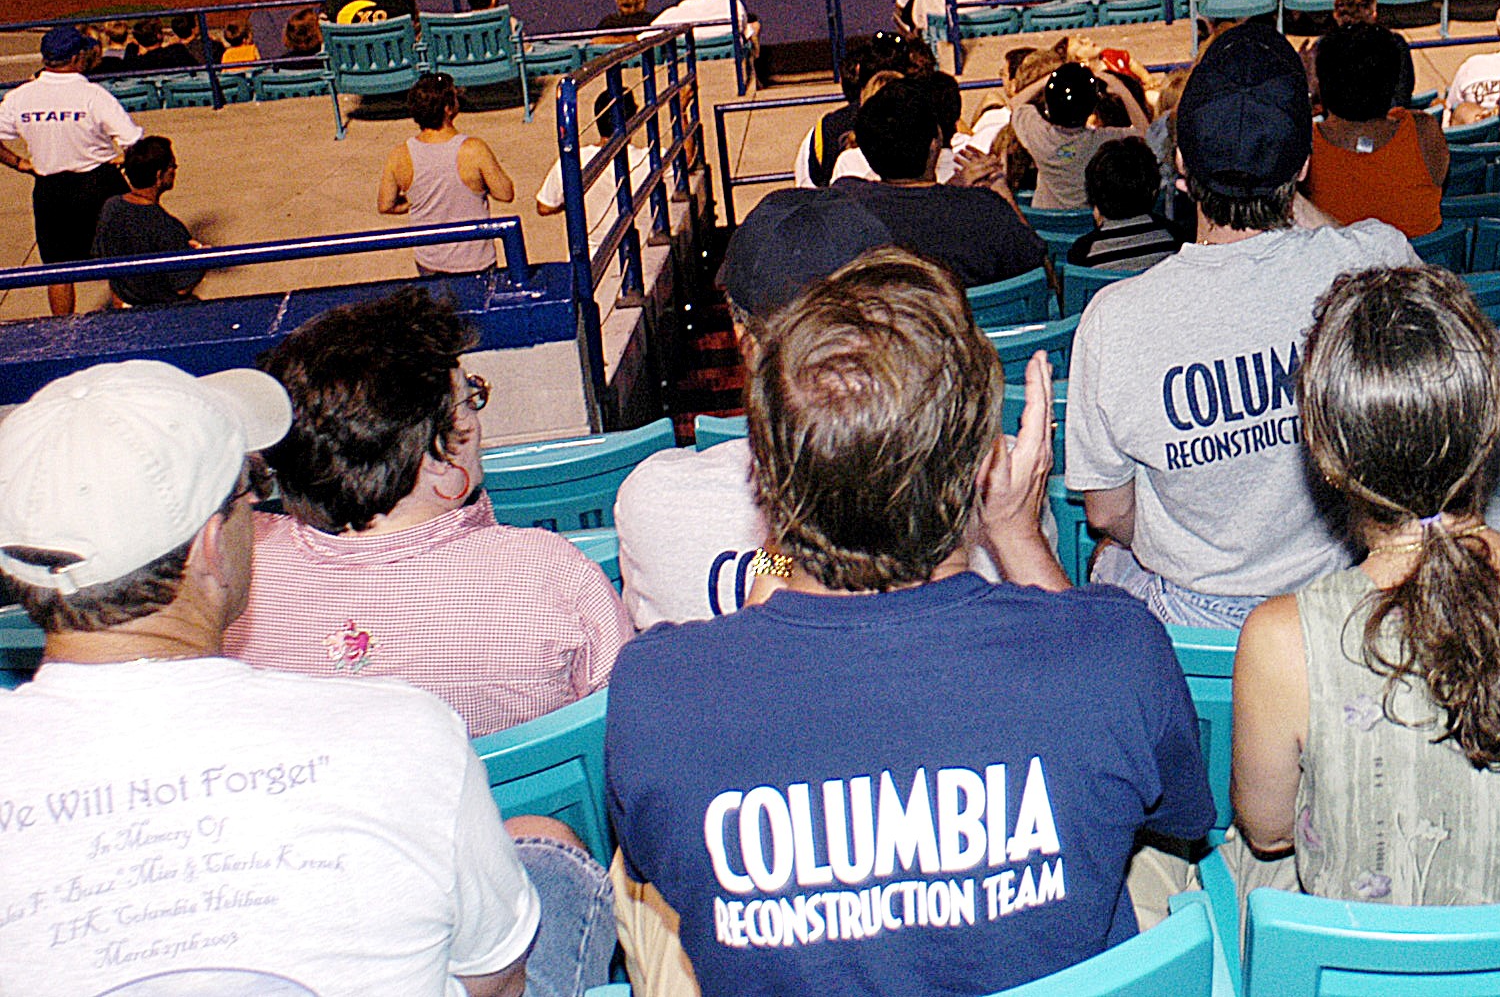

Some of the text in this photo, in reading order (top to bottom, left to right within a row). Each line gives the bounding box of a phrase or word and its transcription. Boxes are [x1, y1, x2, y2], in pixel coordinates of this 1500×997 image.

[21, 111, 86, 123] STAFF
[1163, 341, 1301, 431] COLUM
[1165, 415, 1299, 470] RECONSTRUCT
[46, 784, 114, 824] Will
[128, 774, 190, 811] Not
[87, 814, 230, 859] In Memory Of
[704, 755, 1061, 894] COLUMBIA
[202, 851, 272, 873] Charles
[113, 897, 198, 926] Columbia
[714, 857, 1065, 948] RECONSTRUCTION TEAM
[95, 937, 163, 968] March
